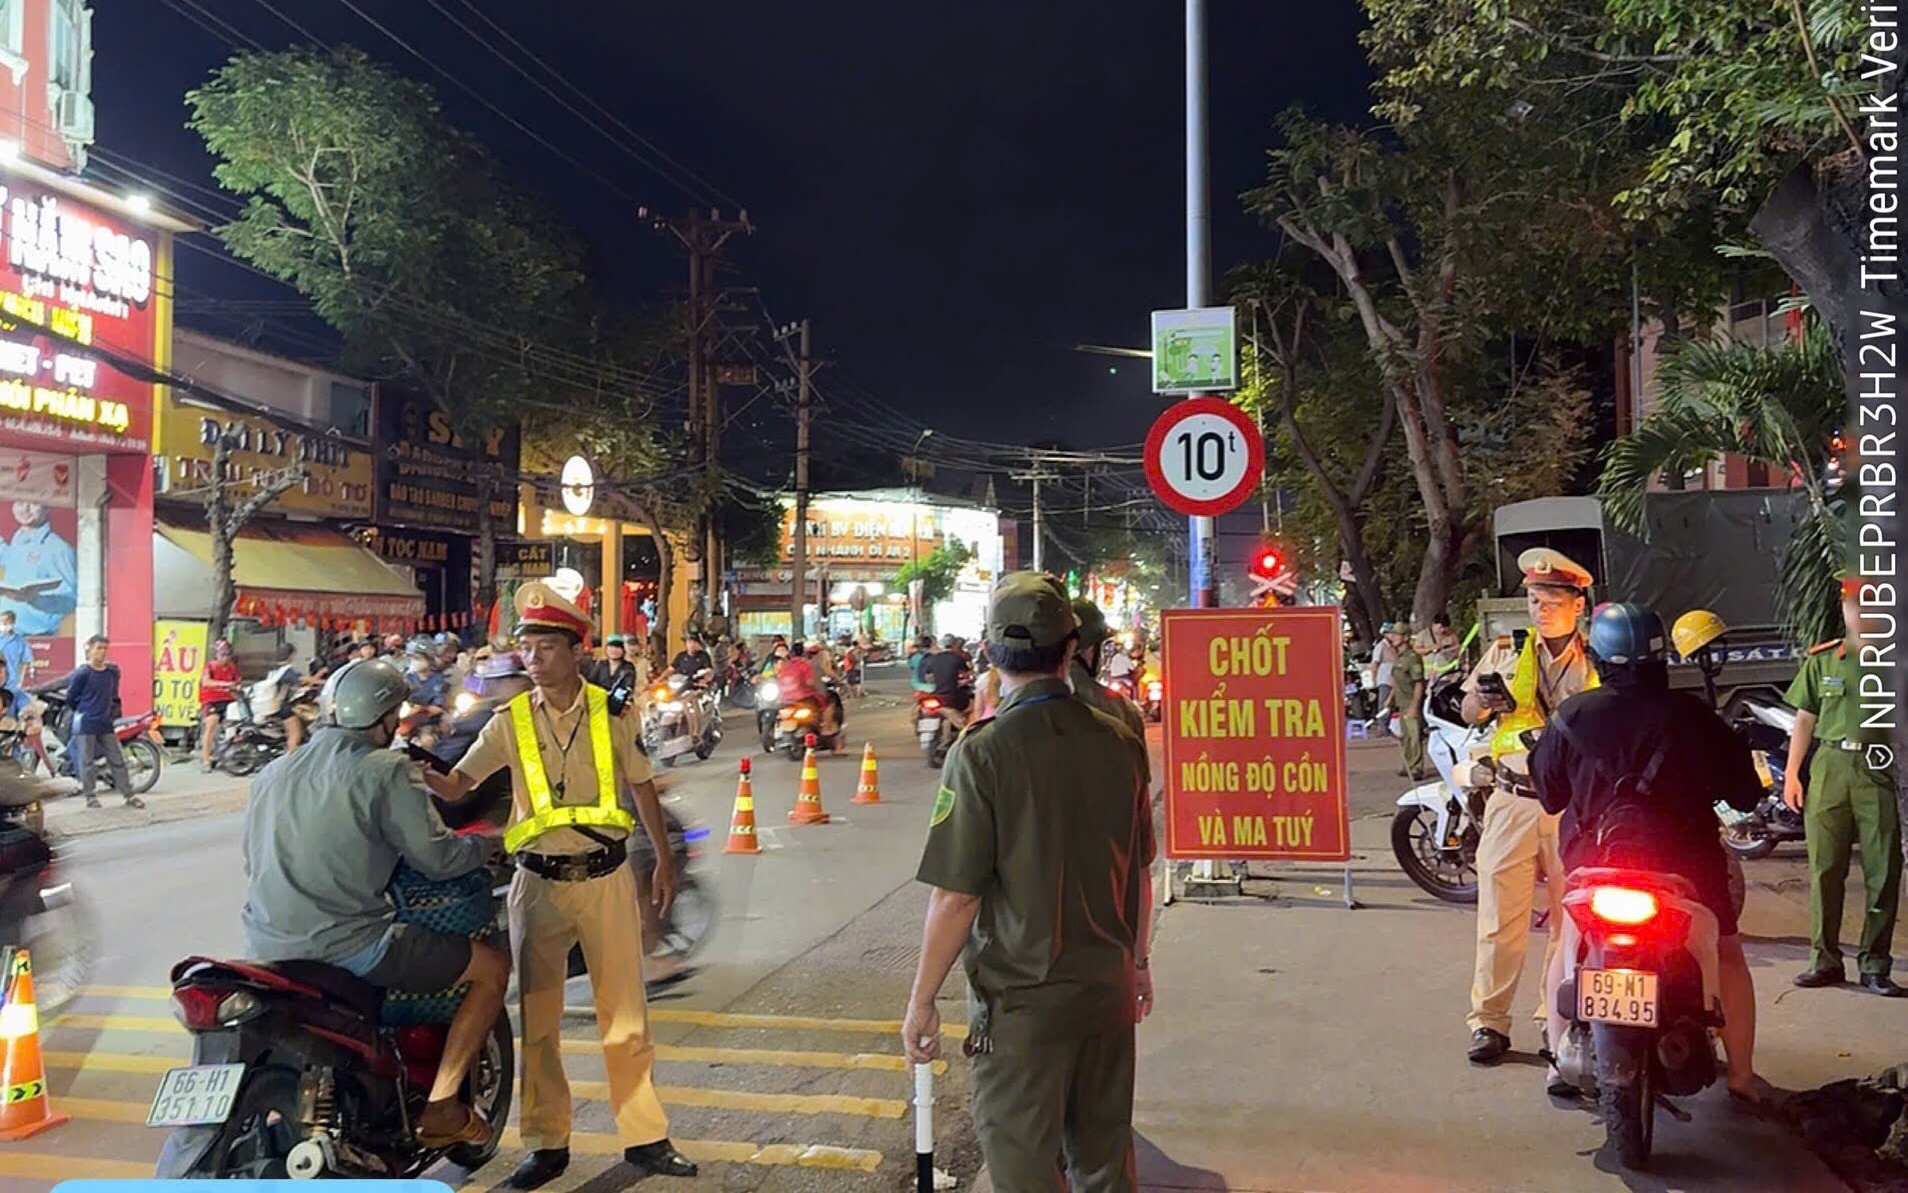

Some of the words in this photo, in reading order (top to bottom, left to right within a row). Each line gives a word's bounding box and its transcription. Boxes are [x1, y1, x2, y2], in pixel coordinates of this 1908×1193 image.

[1209, 623, 1291, 677] CHỐT
[1180, 682, 1256, 738] KIỂM
[1264, 698, 1326, 738] TRA
[1181, 752, 1240, 792] NỒNG
[1246, 756, 1277, 799] ĐỘ
[1283, 752, 1329, 792] CỒN
[1198, 808, 1227, 845] VÀ
[1232, 815, 1267, 846] MA
[1272, 809, 1314, 847] TUÝ
[1584, 995, 1654, 1023] 834.95
